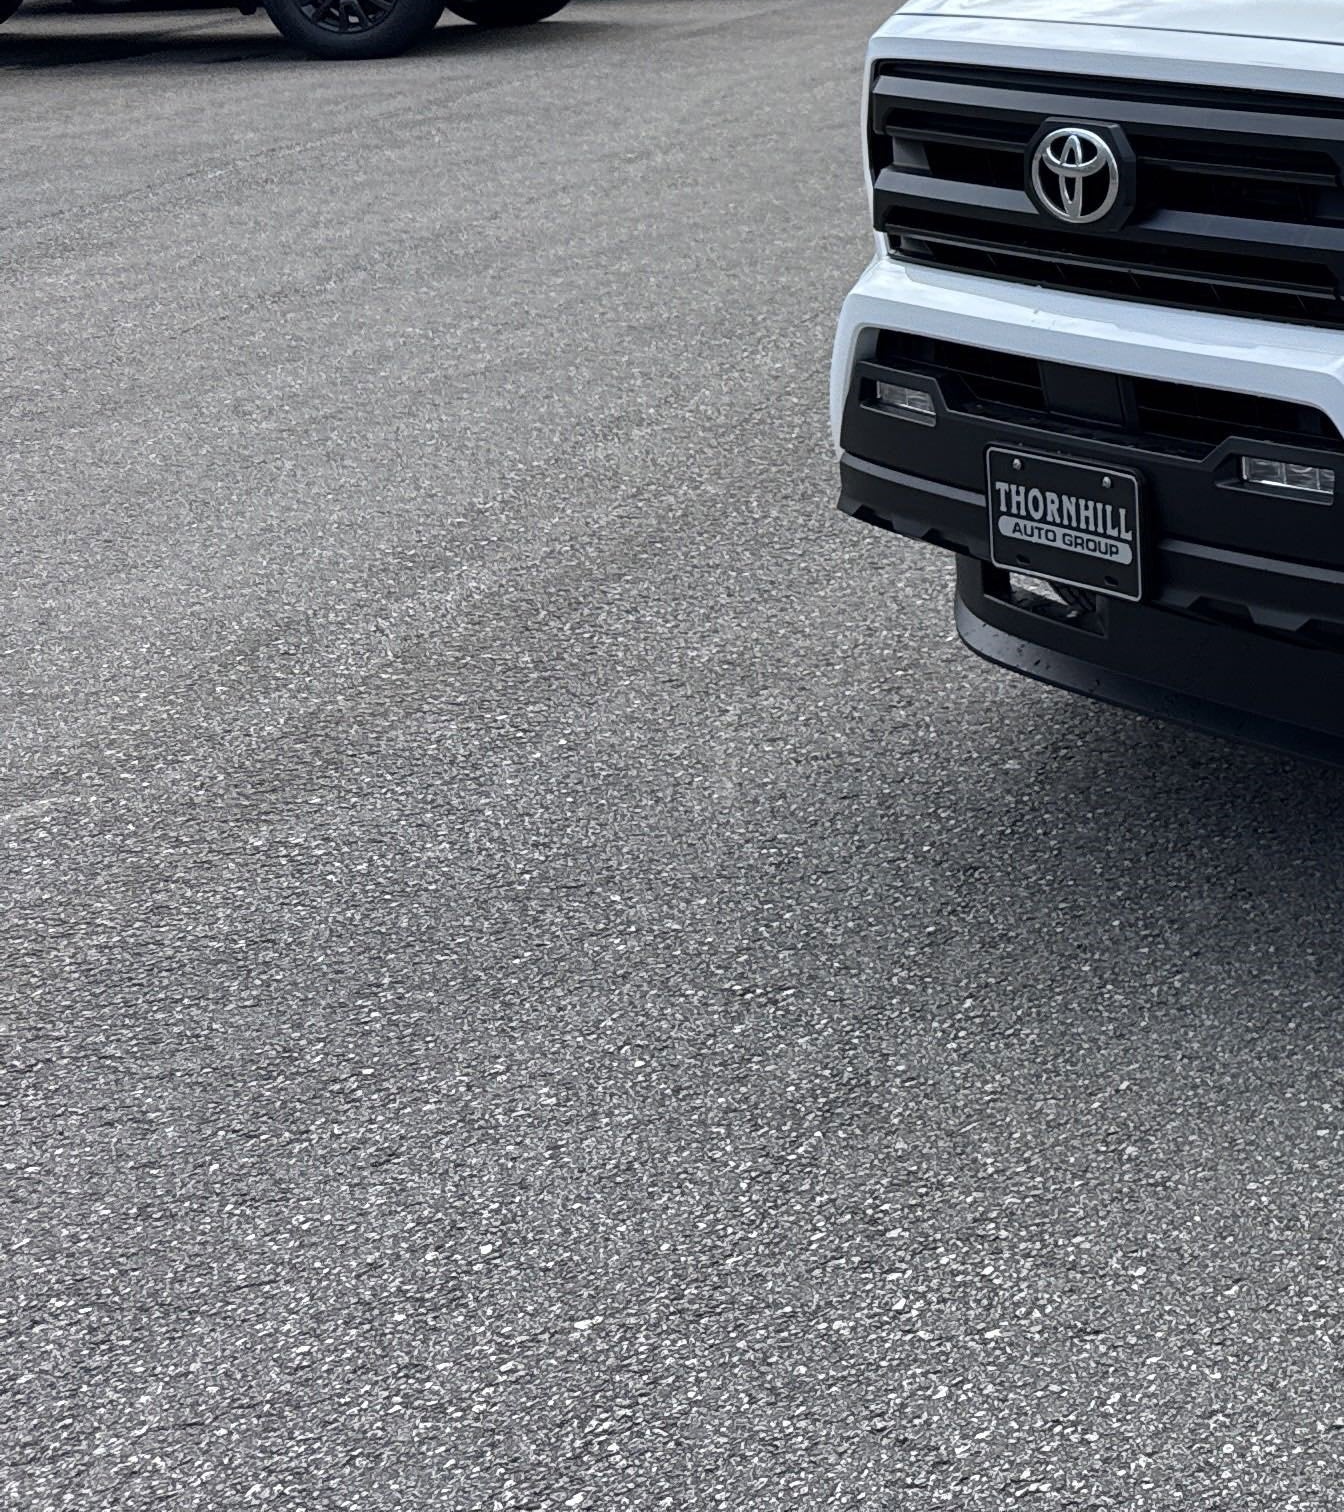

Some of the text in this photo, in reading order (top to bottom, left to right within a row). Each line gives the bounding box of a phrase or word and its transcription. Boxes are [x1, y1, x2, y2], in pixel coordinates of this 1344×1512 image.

[995, 481, 1133, 541] THORNHILL
[1011, 521, 1120, 558] AUTO GROUP
